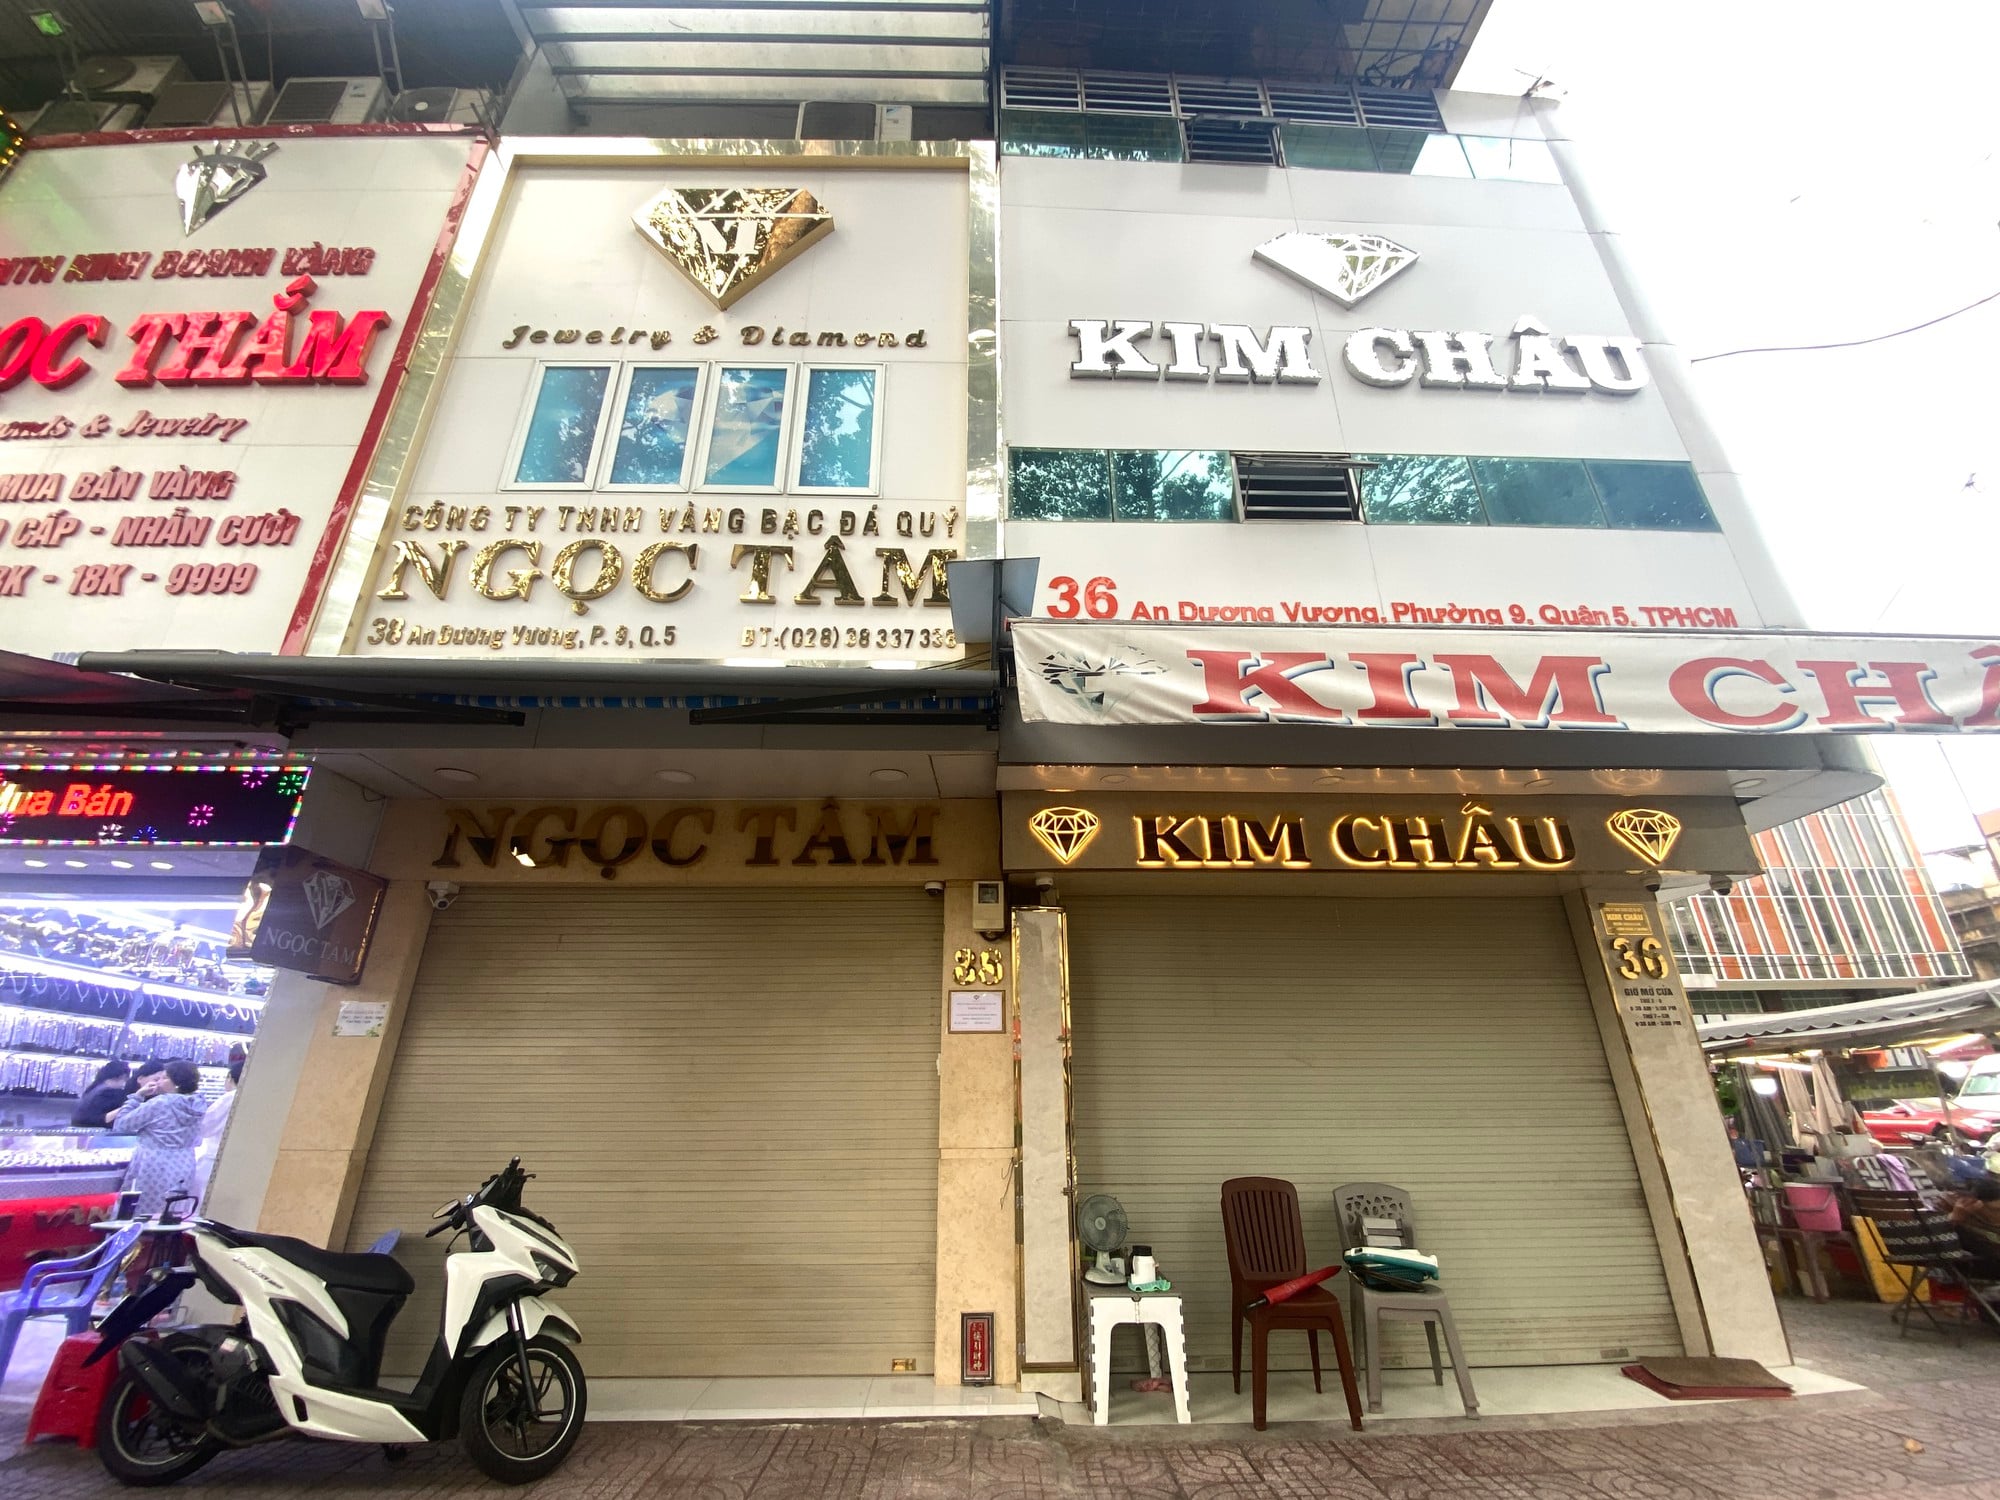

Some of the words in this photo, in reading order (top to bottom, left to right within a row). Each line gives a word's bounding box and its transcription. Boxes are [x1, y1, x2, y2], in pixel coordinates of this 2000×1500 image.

[502, 325, 672, 351] Jewelry
[692, 325, 719, 346] &
[740, 325, 928, 349] Diamond
[1068, 319, 1322, 385] KIM
[1342, 315, 1649, 394] CHÂU
[80, 414, 112, 438] &
[117, 410, 248, 442] Jewelry
[69, 465, 145, 502] BÁN
[148, 464, 238, 500] VÀNG
[12, 508, 82, 547] CẤP
[402, 500, 491, 531] CÔNG
[505, 505, 545, 532] TY
[558, 505, 643, 533] TNHH
[659, 501, 744, 534] VÀNG
[760, 508, 824, 540] BẠC
[896, 505, 960, 539] QUÝ
[68, 564, 134, 596] 18K
[165, 563, 258, 595] 9999
[376, 538, 699, 617] NGỌC
[730, 535, 958, 608] TÂM
[1046, 576, 1119, 619] 36
[1131, 600, 1169, 621] An
[1639, 606, 1738, 628] TPHCM
[367, 617, 405, 645] 38
[406, 625, 434, 645] An
[1186, 650, 1629, 731] KIM
[58, 784, 135, 817] Bán
[432, 806, 716, 881] NGỌC
[737, 797, 942, 867] TÂM
[1134, 815, 1311, 867] KIM
[1330, 802, 1578, 868] CHÂU
[262, 927, 317, 957] NGỌC
[1613, 937, 1669, 980] 36
[953, 948, 1004, 986] 38
